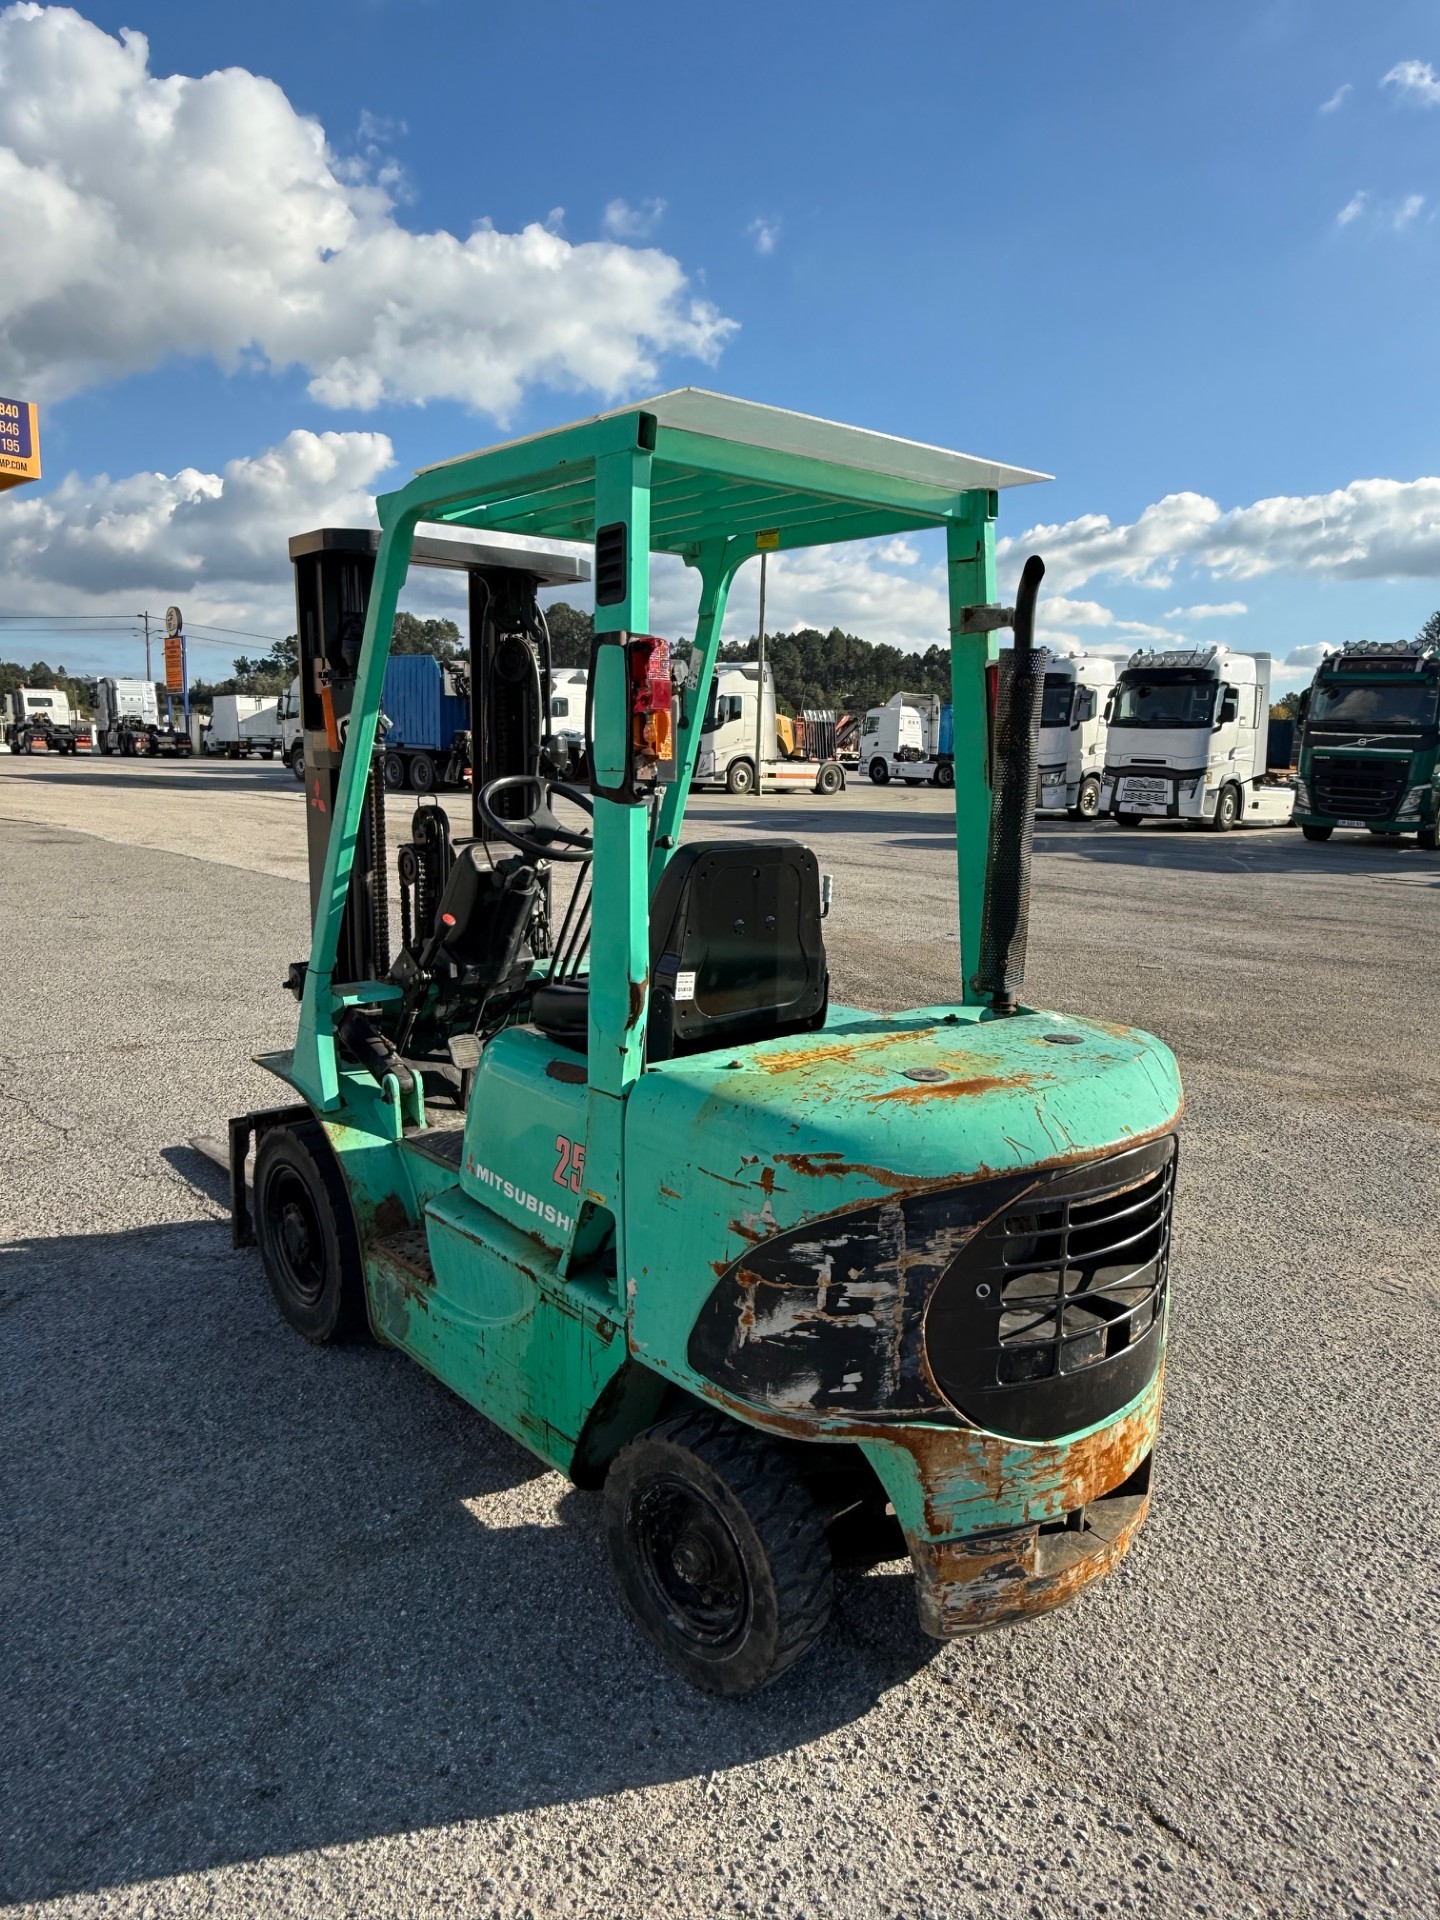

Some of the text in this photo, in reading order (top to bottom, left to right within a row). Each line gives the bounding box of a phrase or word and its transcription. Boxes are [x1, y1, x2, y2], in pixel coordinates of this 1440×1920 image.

[0, 421, 20, 436] 846
[2, 438, 20, 453] 195
[553, 1134, 587, 1195] 25
